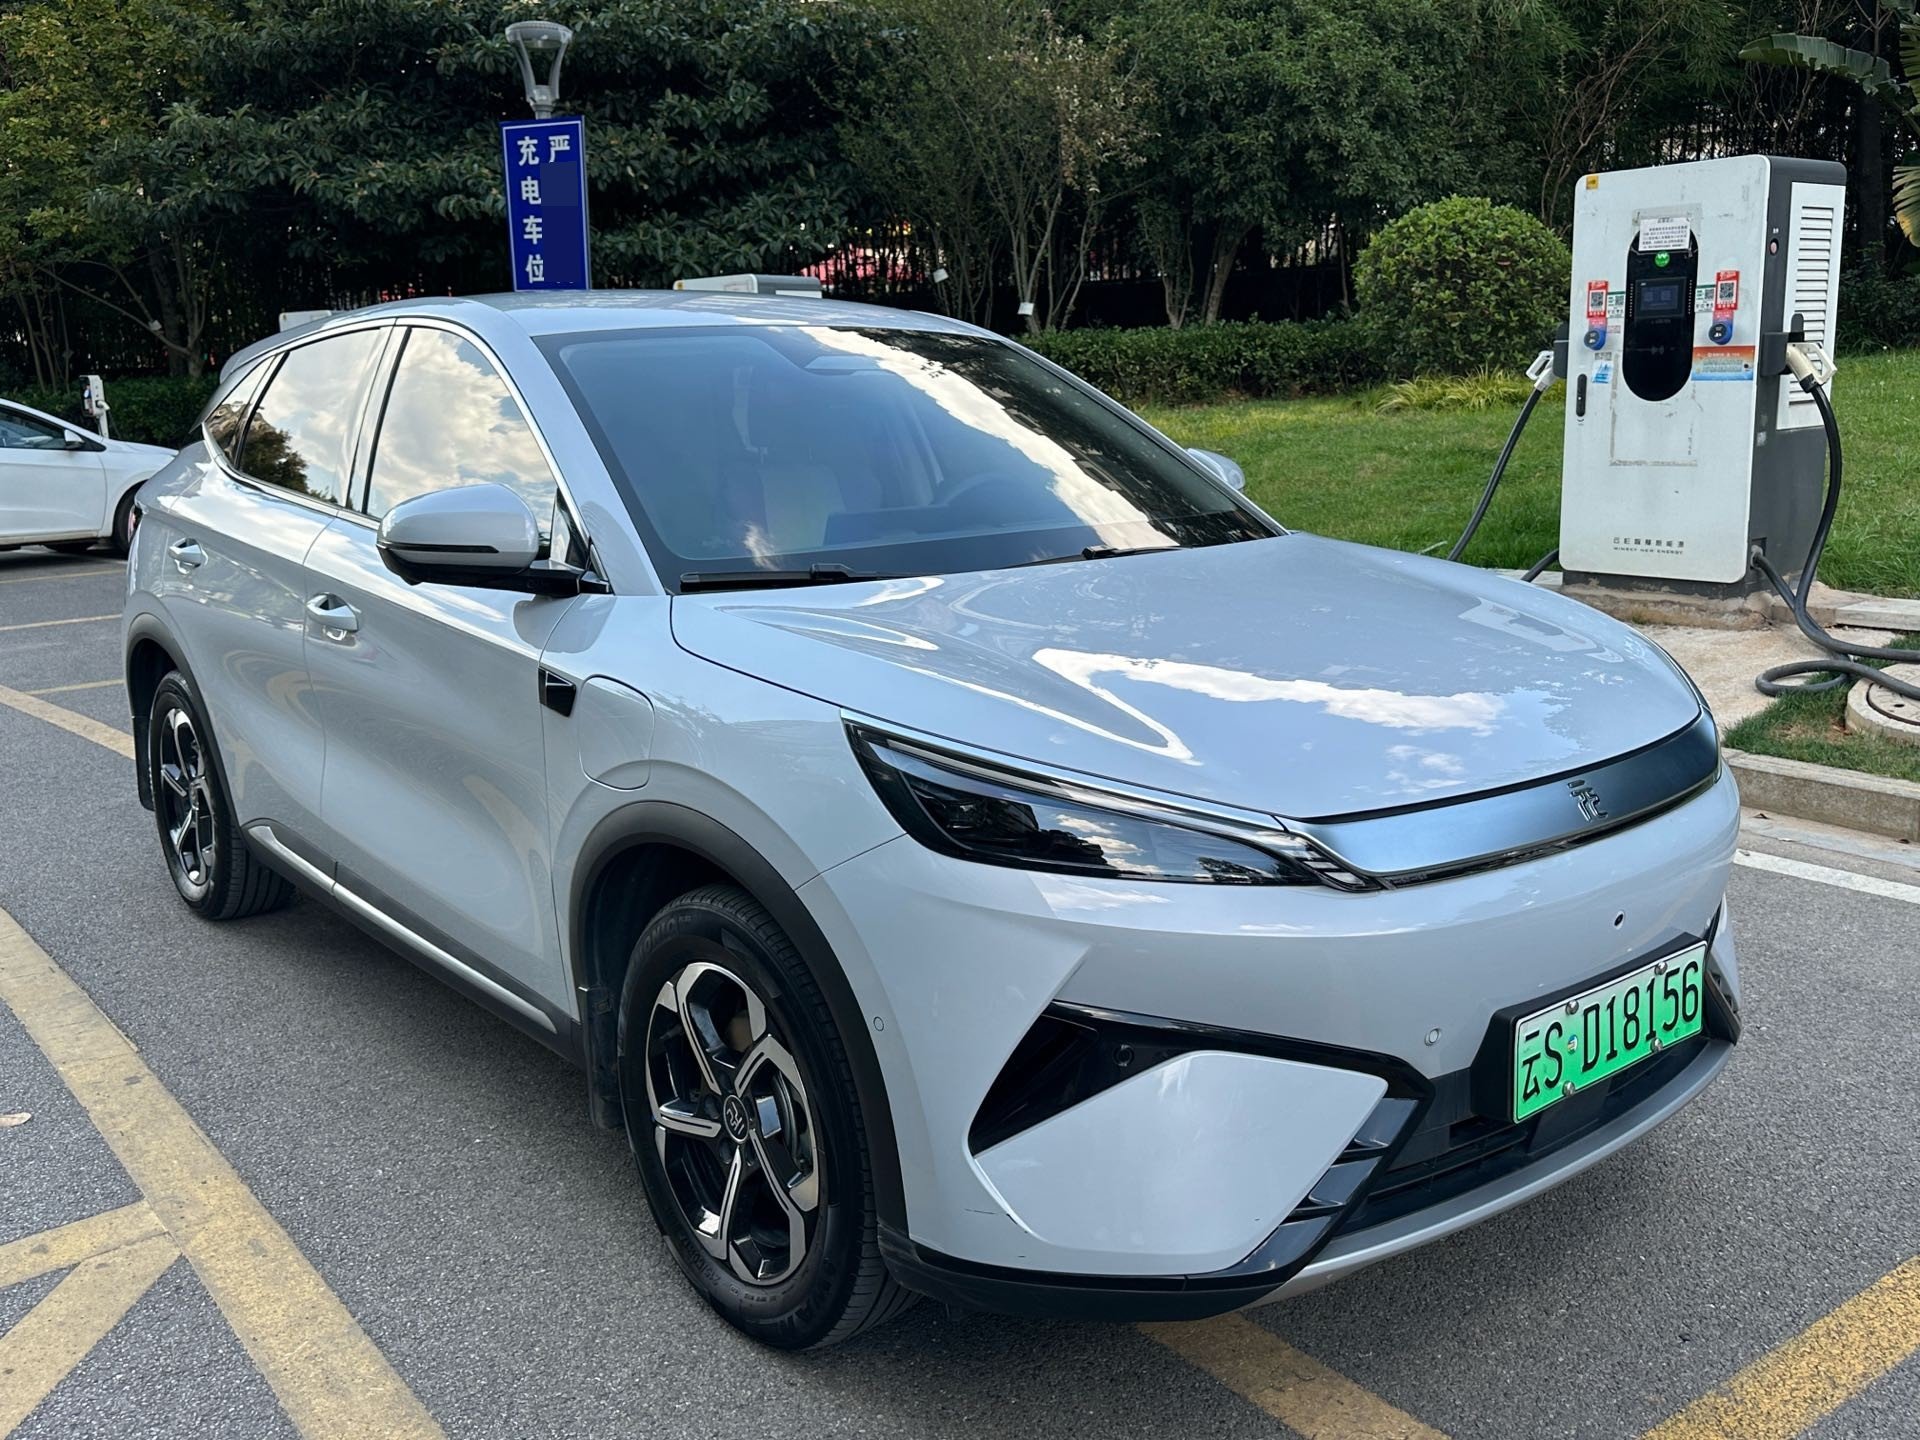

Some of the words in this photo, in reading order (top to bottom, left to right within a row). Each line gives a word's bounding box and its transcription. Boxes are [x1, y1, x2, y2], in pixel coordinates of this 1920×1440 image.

[517, 136, 545, 284] 充电车位
[1521, 1021, 1564, 1103] 云S
[1580, 960, 1700, 1073] D18156
